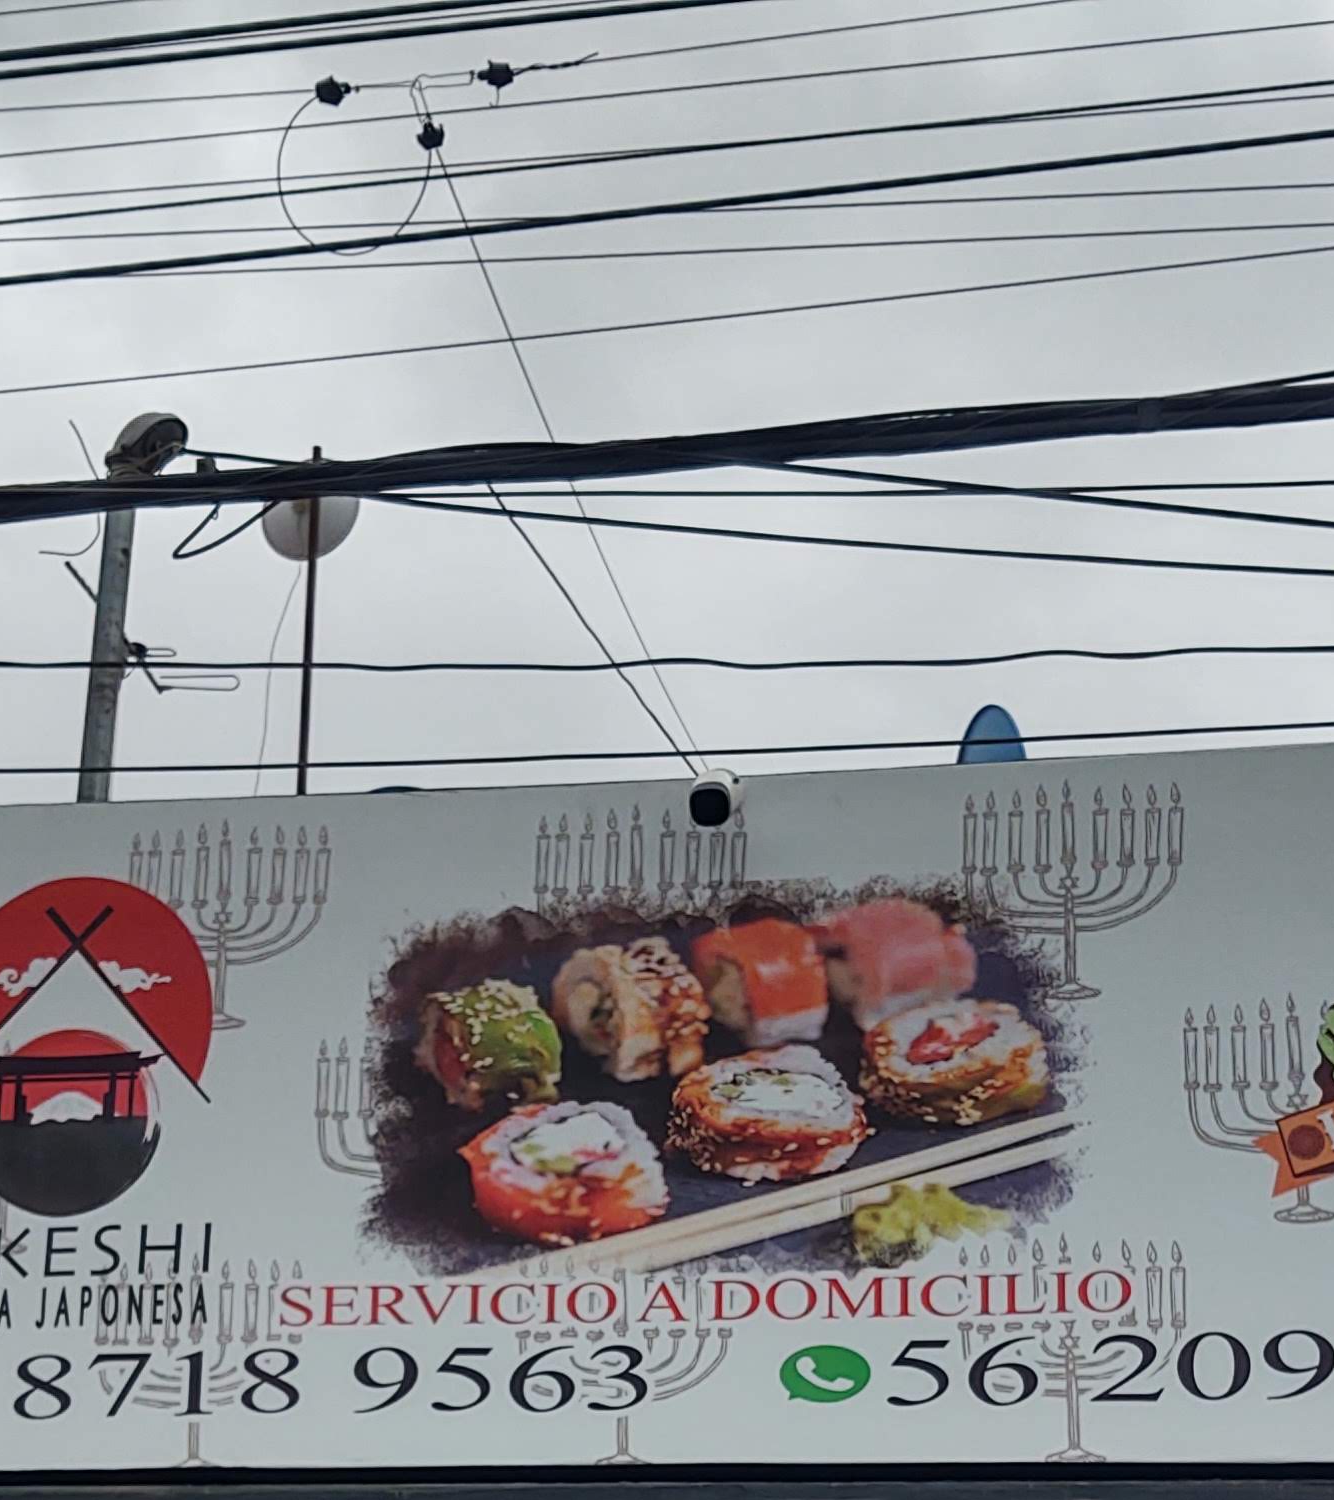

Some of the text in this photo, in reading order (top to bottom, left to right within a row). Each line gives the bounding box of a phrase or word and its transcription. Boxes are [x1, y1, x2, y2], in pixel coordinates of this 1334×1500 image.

[36, 1285, 208, 1329] JAPONESA
[279, 1270, 1133, 1327] SERVICIO A DOMICILIO
[13, 1347, 300, 1420] 8718
[353, 1345, 648, 1414] 9563
[886, 1335, 1039, 1406] 56
